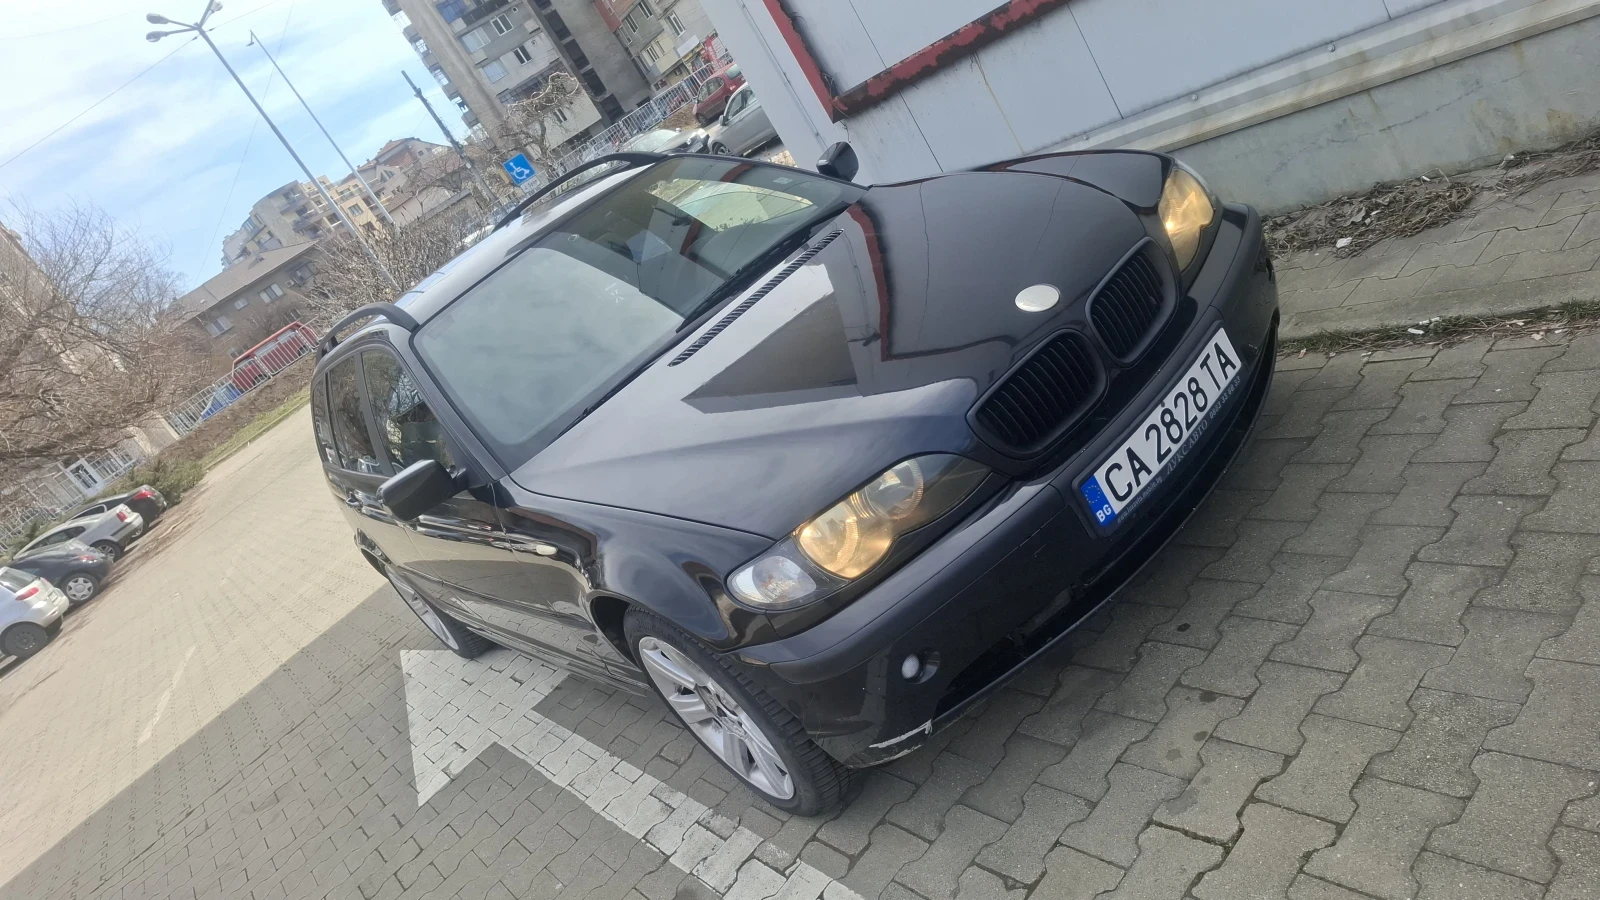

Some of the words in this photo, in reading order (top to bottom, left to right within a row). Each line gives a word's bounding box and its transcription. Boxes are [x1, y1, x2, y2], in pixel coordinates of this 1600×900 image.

[1105, 447, 1152, 502] CA
[1145, 377, 1208, 465] 2828
[1200, 342, 1237, 390] TA
[1096, 504, 1111, 522] BG
